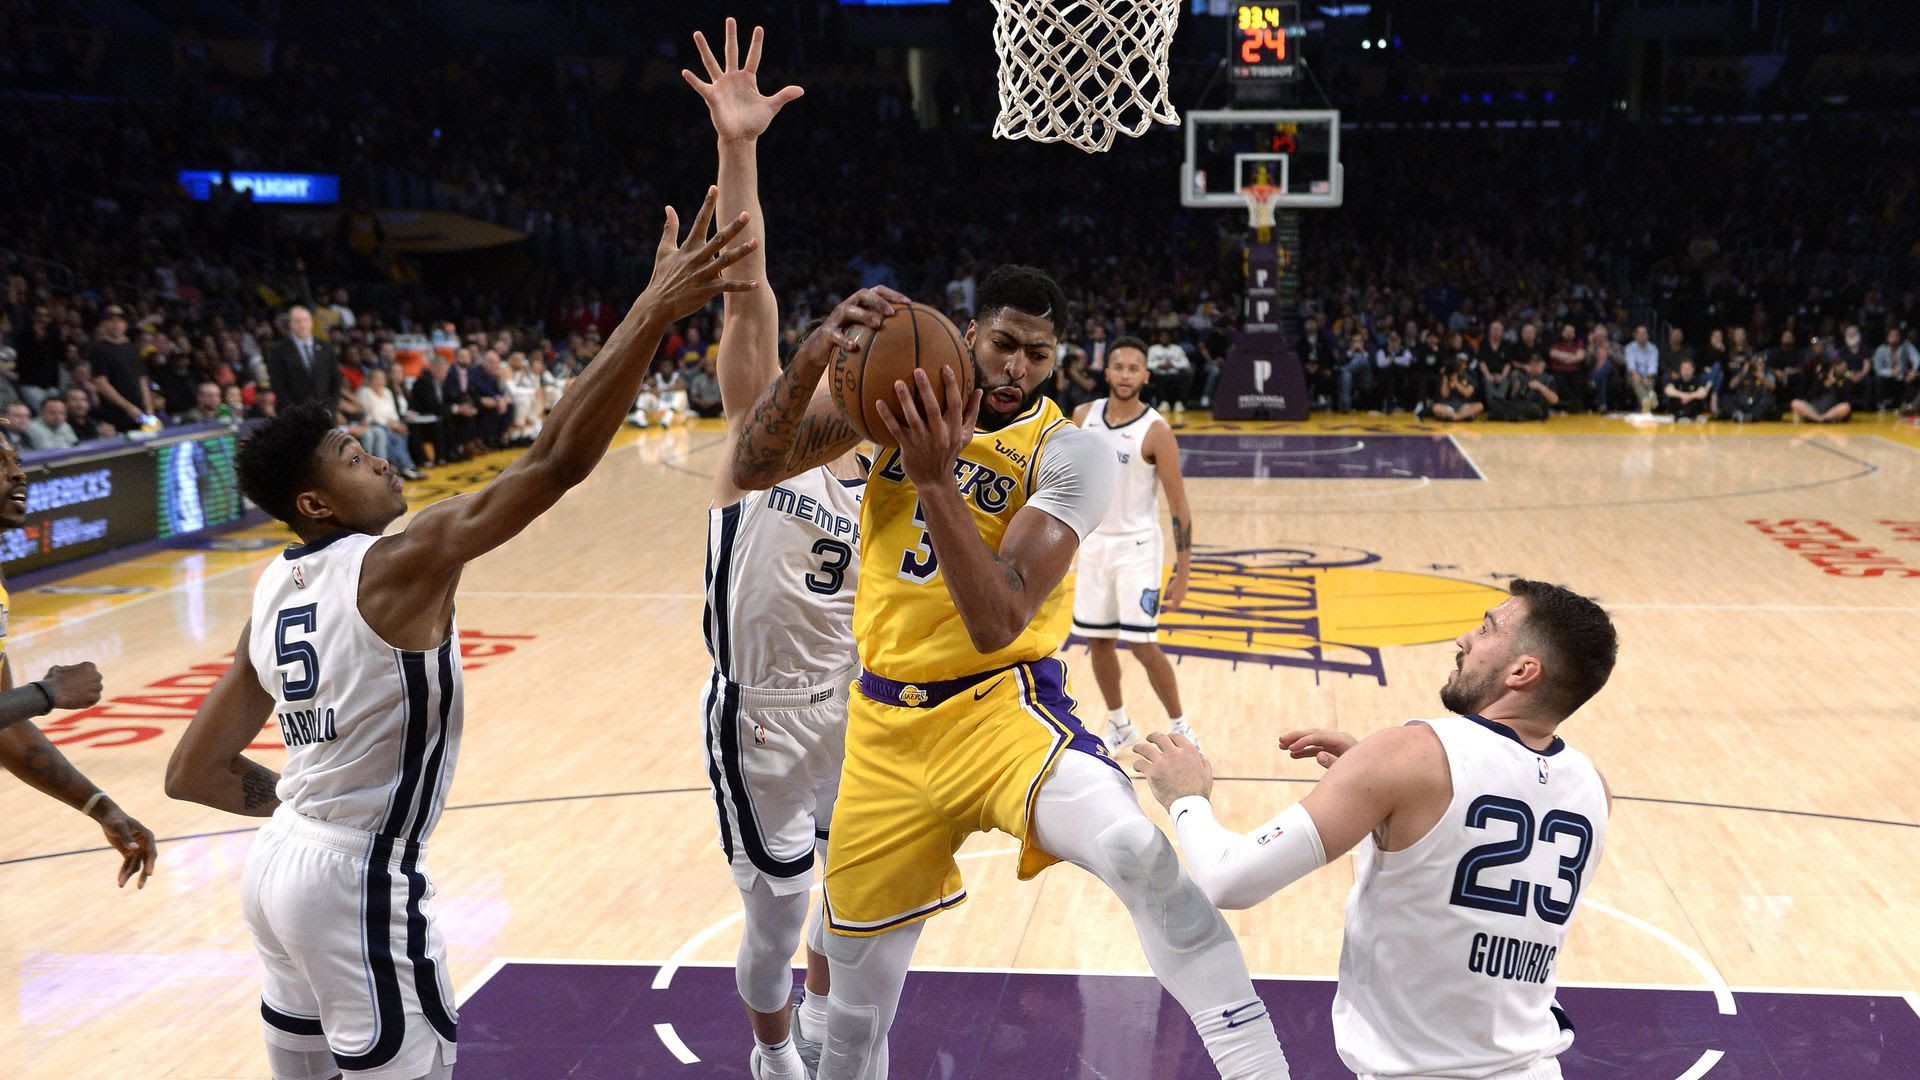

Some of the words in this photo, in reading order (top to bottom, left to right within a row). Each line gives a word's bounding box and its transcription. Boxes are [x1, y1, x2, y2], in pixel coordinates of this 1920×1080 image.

[1238, 6, 1279, 29] 33.4
[1242, 27, 1285, 62] 24
[878, 446, 1018, 515] LERS
[994, 439, 1027, 469] wish
[26, 469, 112, 514] AVERICKS
[805, 538, 851, 596] 3
[275, 602, 320, 702] 5
[1449, 794, 1593, 926] 23
[1468, 932, 1557, 985] GUDURIC
